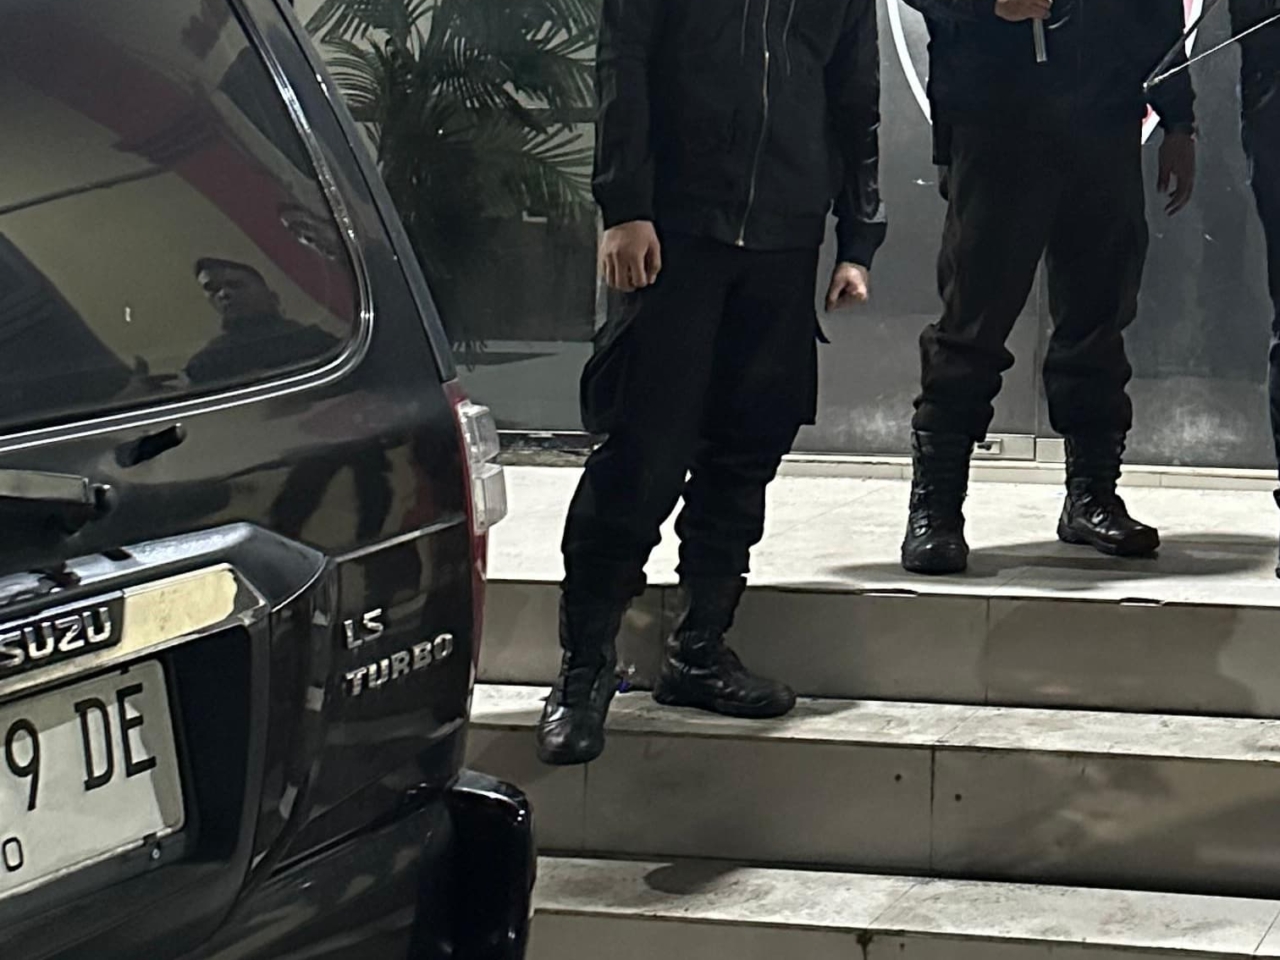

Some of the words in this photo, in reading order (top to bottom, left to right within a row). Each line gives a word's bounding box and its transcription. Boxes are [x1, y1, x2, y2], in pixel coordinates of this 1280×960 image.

[343, 608, 384, 650] LS
[345, 633, 453, 696] TURBO
[5, 718, 40, 811] 9
[74, 682, 157, 792] DE
